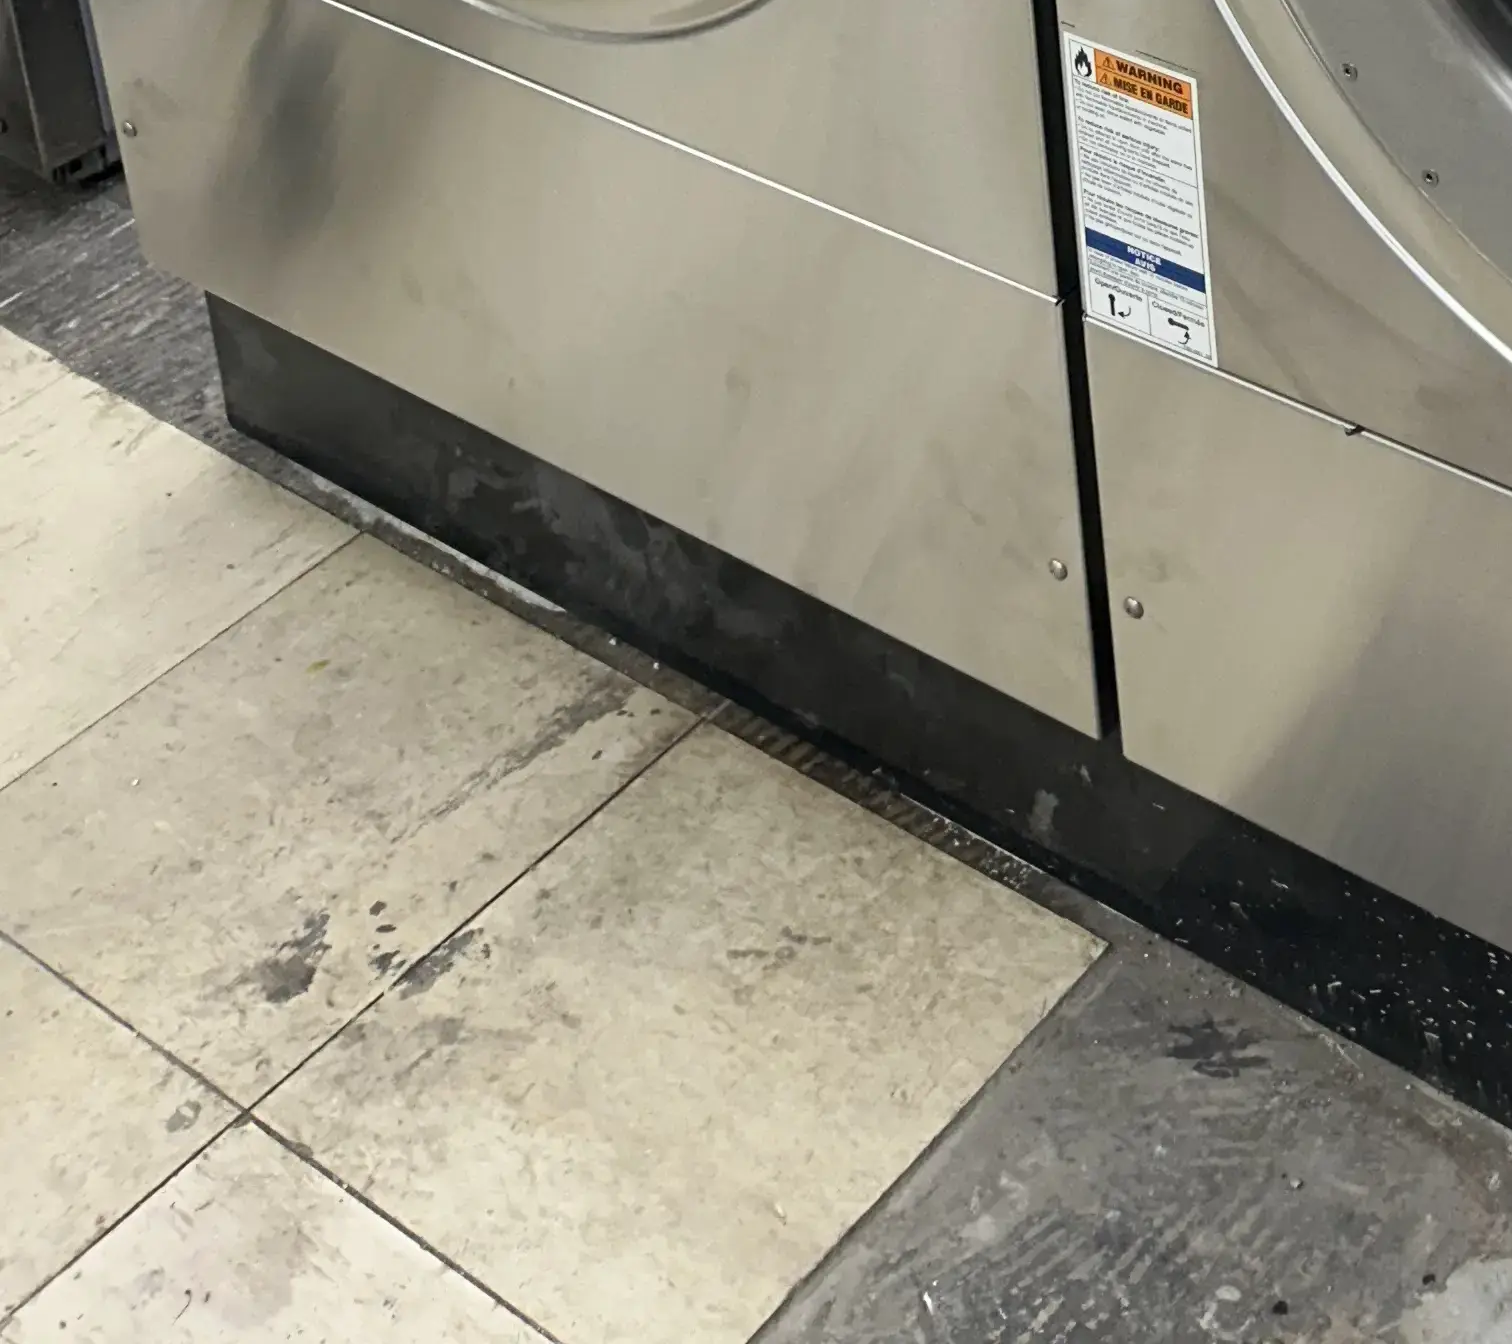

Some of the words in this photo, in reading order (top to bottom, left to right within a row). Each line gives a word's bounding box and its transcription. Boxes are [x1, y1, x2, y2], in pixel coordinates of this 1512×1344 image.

[1116, 59, 1184, 95] WARNING
[1113, 76, 1138, 96] MISE
[1140, 87, 1153, 101] EN
[1155, 92, 1189, 115] GARDE
[1127, 245, 1162, 266] NOTICE
